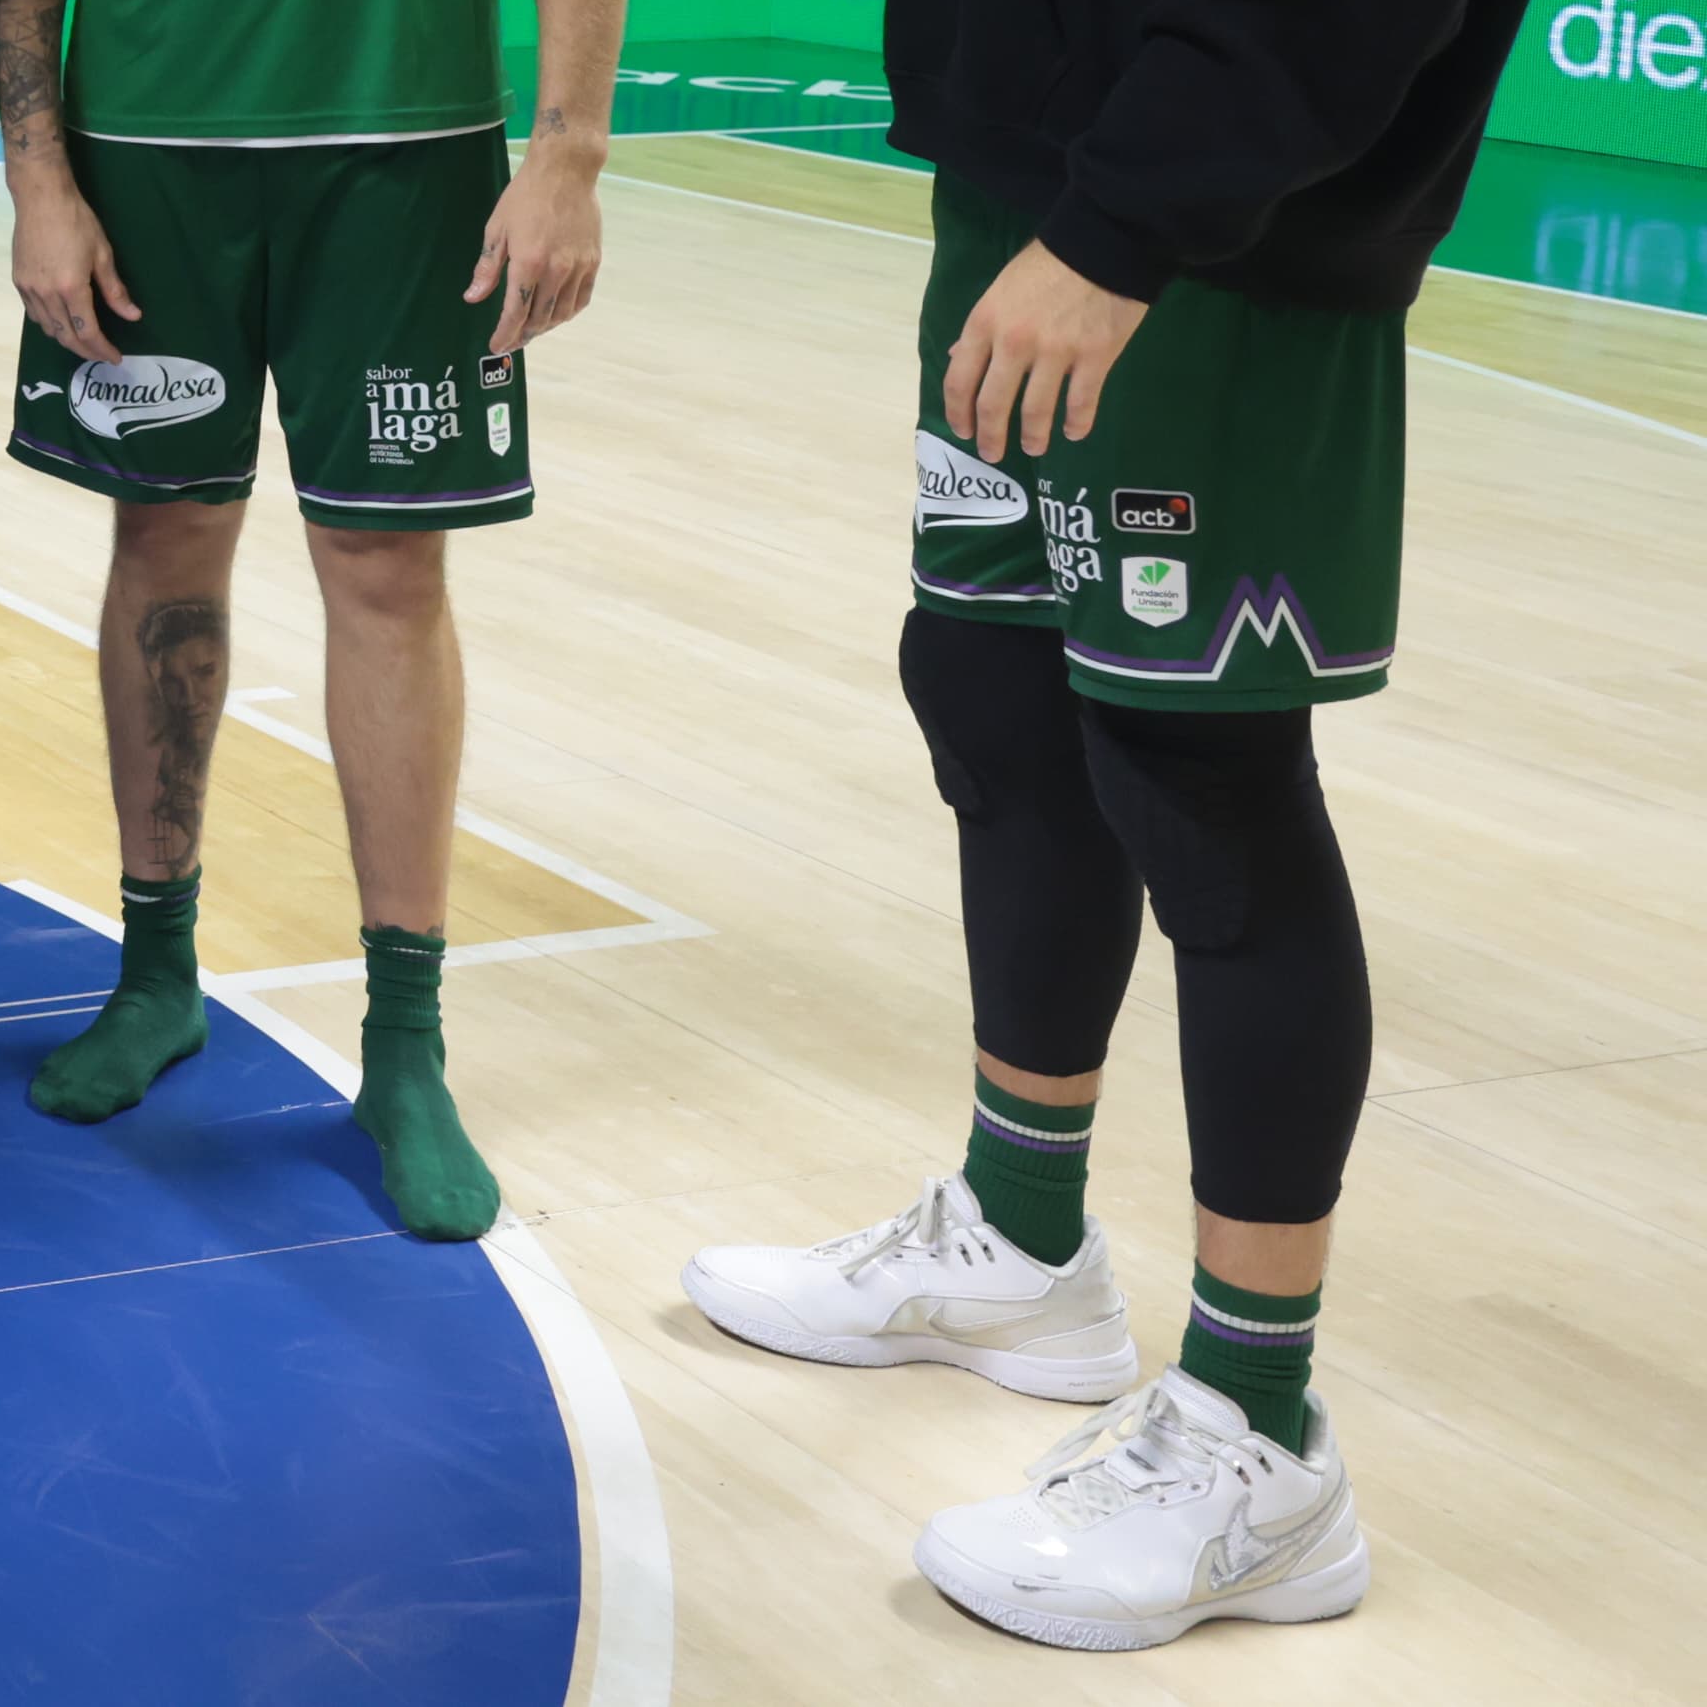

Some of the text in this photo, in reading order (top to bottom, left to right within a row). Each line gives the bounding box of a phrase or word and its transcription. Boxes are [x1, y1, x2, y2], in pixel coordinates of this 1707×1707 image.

[365, 363, 413, 381] sabor
[484, 366, 507, 385] acb
[74, 360, 217, 408] famadesa
[365, 365, 462, 412] a má
[365, 401, 464, 454] laga
[1121, 507, 1176, 528] acb
[1046, 543, 1104, 593] aga
[1130, 587, 1179, 600] Fundación
[1138, 598, 1173, 608] Unicaja
